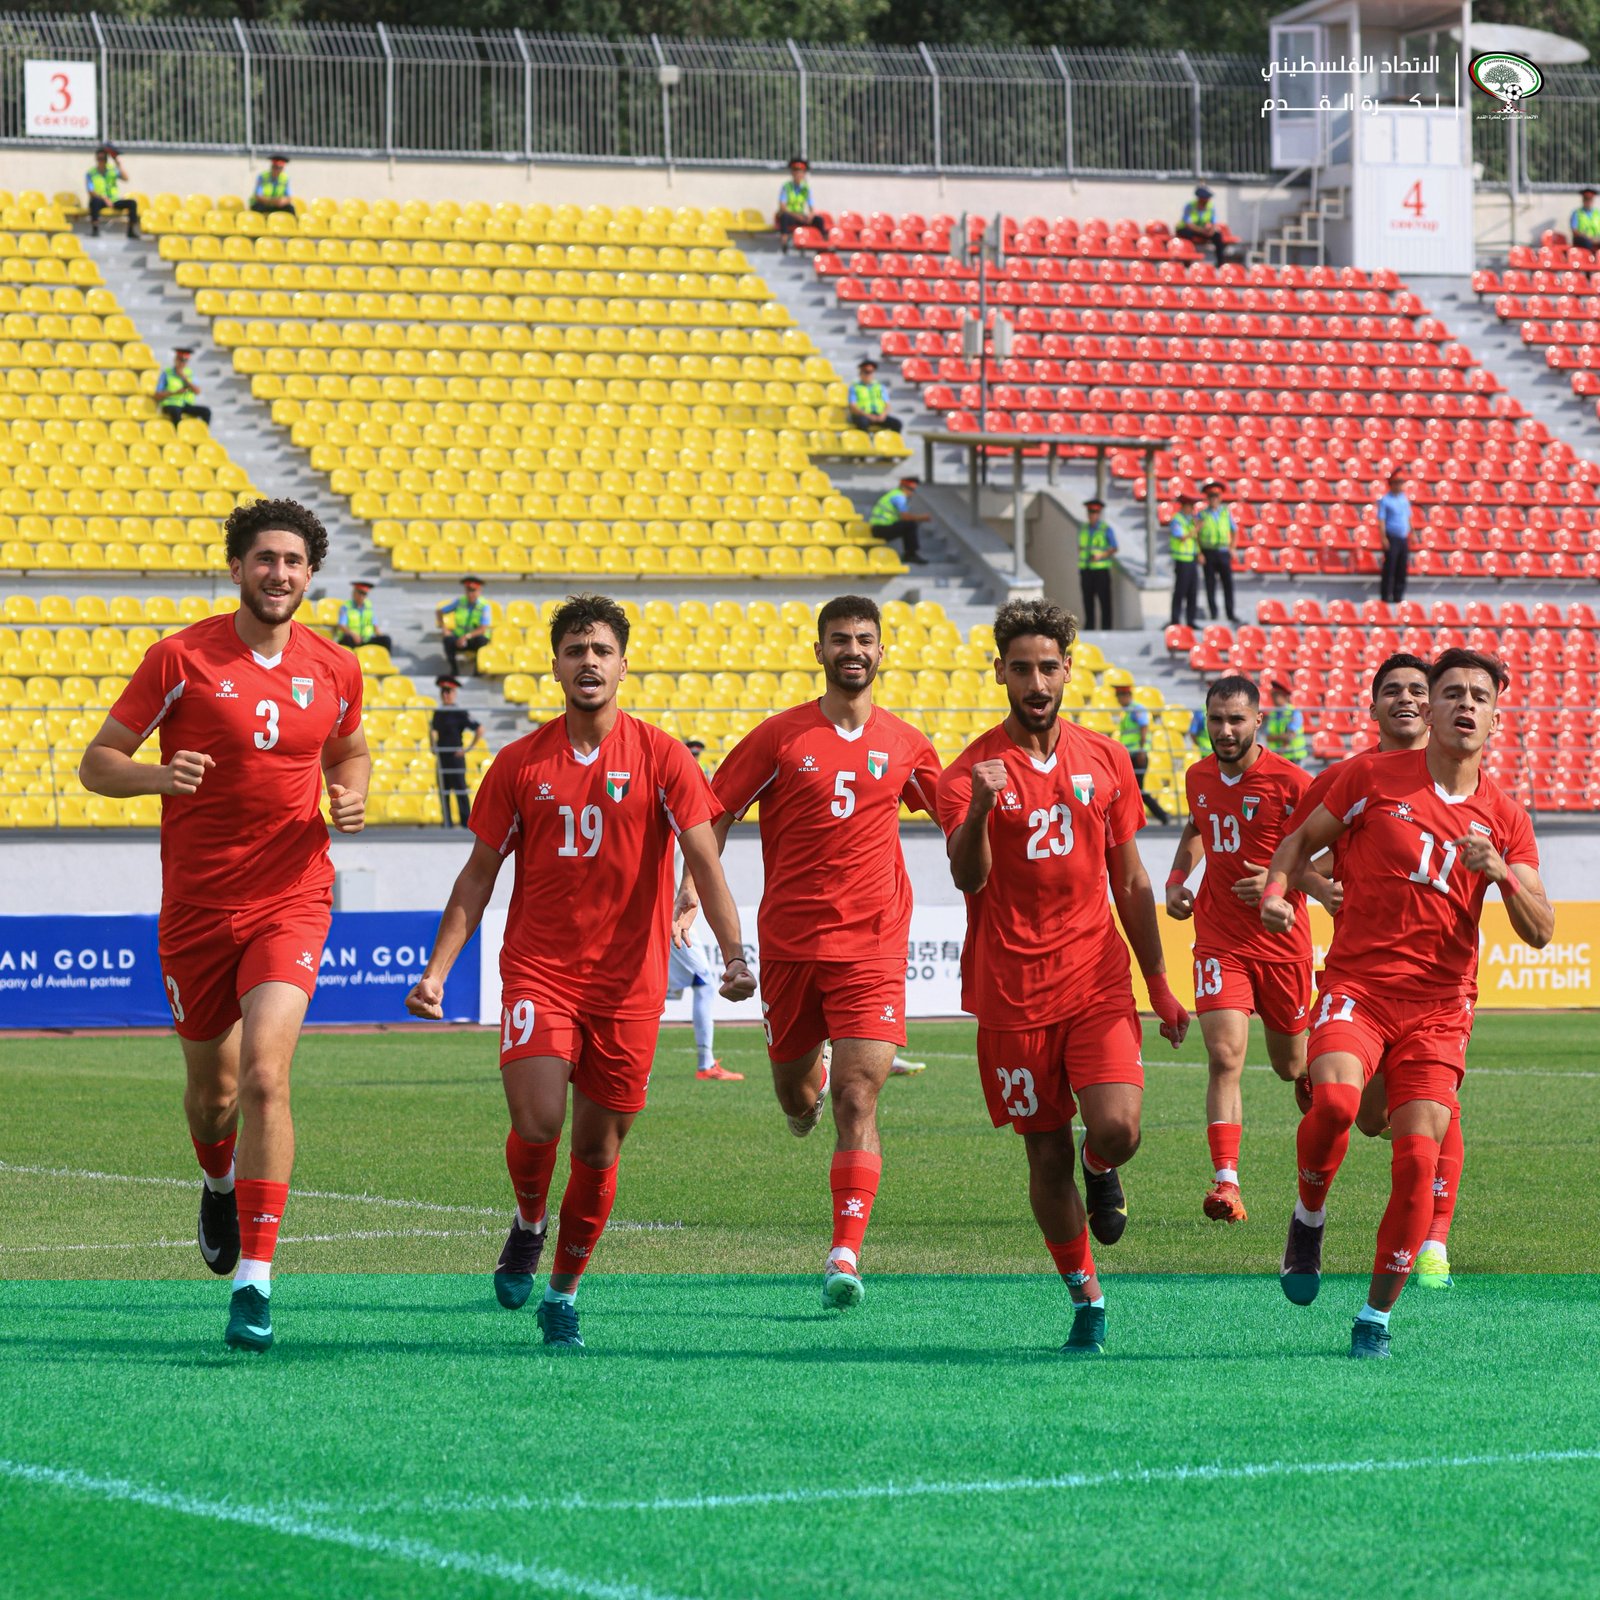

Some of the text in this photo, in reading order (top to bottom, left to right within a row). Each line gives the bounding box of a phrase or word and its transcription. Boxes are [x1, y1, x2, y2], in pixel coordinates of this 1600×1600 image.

[49, 72, 72, 113] 3
[1401, 178, 1426, 219] 4
[253, 699, 280, 750] 3
[830, 770, 857, 820] 5
[1001, 803, 1023, 811] KELME
[557, 803, 604, 858] 19
[1026, 803, 1075, 860] 23
[1209, 812, 1241, 854] 13
[1390, 810, 1415, 823] KELME
[1408, 830, 1458, 895] 11
[53, 948, 136, 970] GOLD
[372, 945, 429, 968] GOL
[1488, 942, 1592, 966] АЛЬЯНС
[31, 973, 44, 989] of
[45, 973, 88, 989] Avelum
[90, 975, 132, 990] partner
[350, 969, 363, 986] of
[364, 969, 406, 985] Avelum
[1195, 957, 1223, 999] 13
[1497, 967, 1592, 990] АЛТЫН
[166, 974, 186, 1023] 3
[501, 999, 536, 1055] 19
[996, 1066, 1039, 1118] 23
[840, 1209, 864, 1219] KELME
